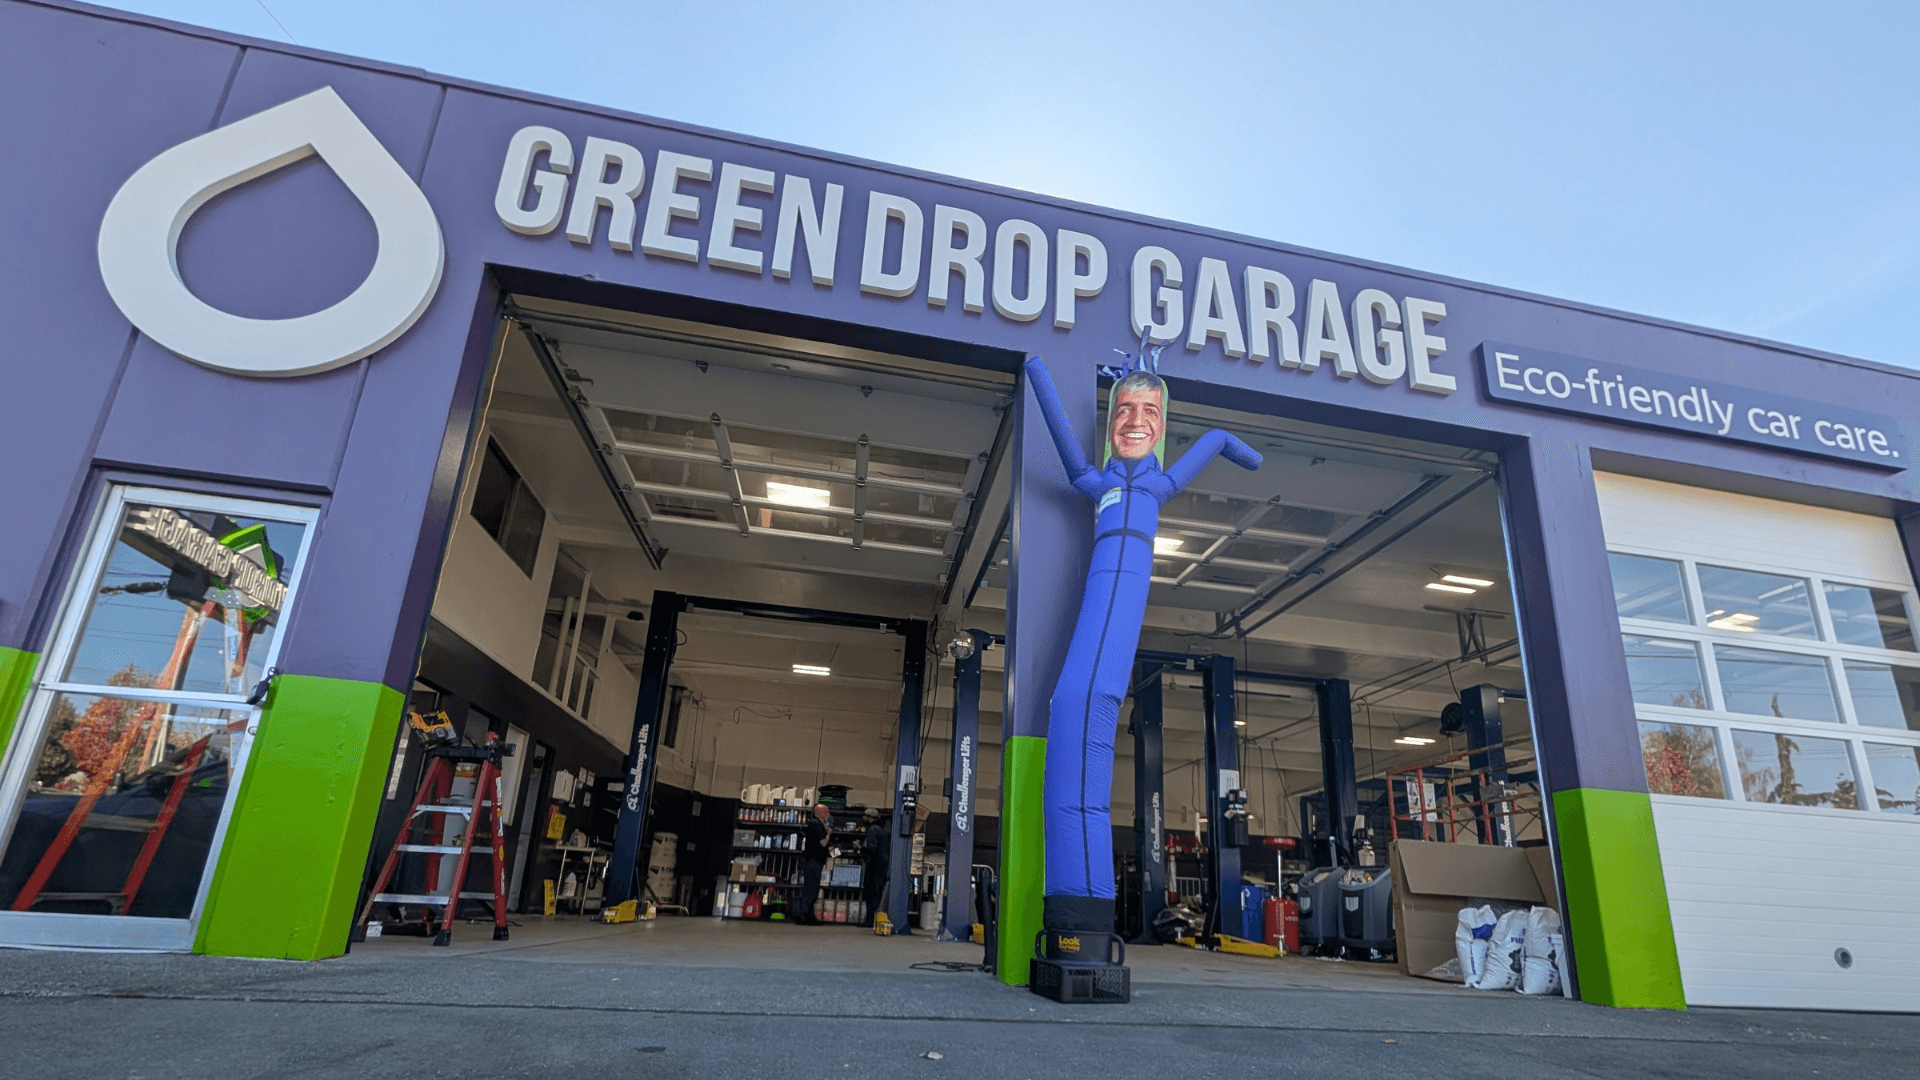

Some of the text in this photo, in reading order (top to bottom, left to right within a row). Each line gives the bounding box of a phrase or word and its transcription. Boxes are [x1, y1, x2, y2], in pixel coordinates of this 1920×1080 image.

[495, 125, 1457, 395] GREEN DROP GARAGE
[1494, 351, 1900, 458] Eco-friendly car care.
[638, 723, 650, 743] Lifts
[961, 735, 971, 757] Lifts
[630, 743, 647, 795] Challenger
[957, 757, 972, 813] Challenger
